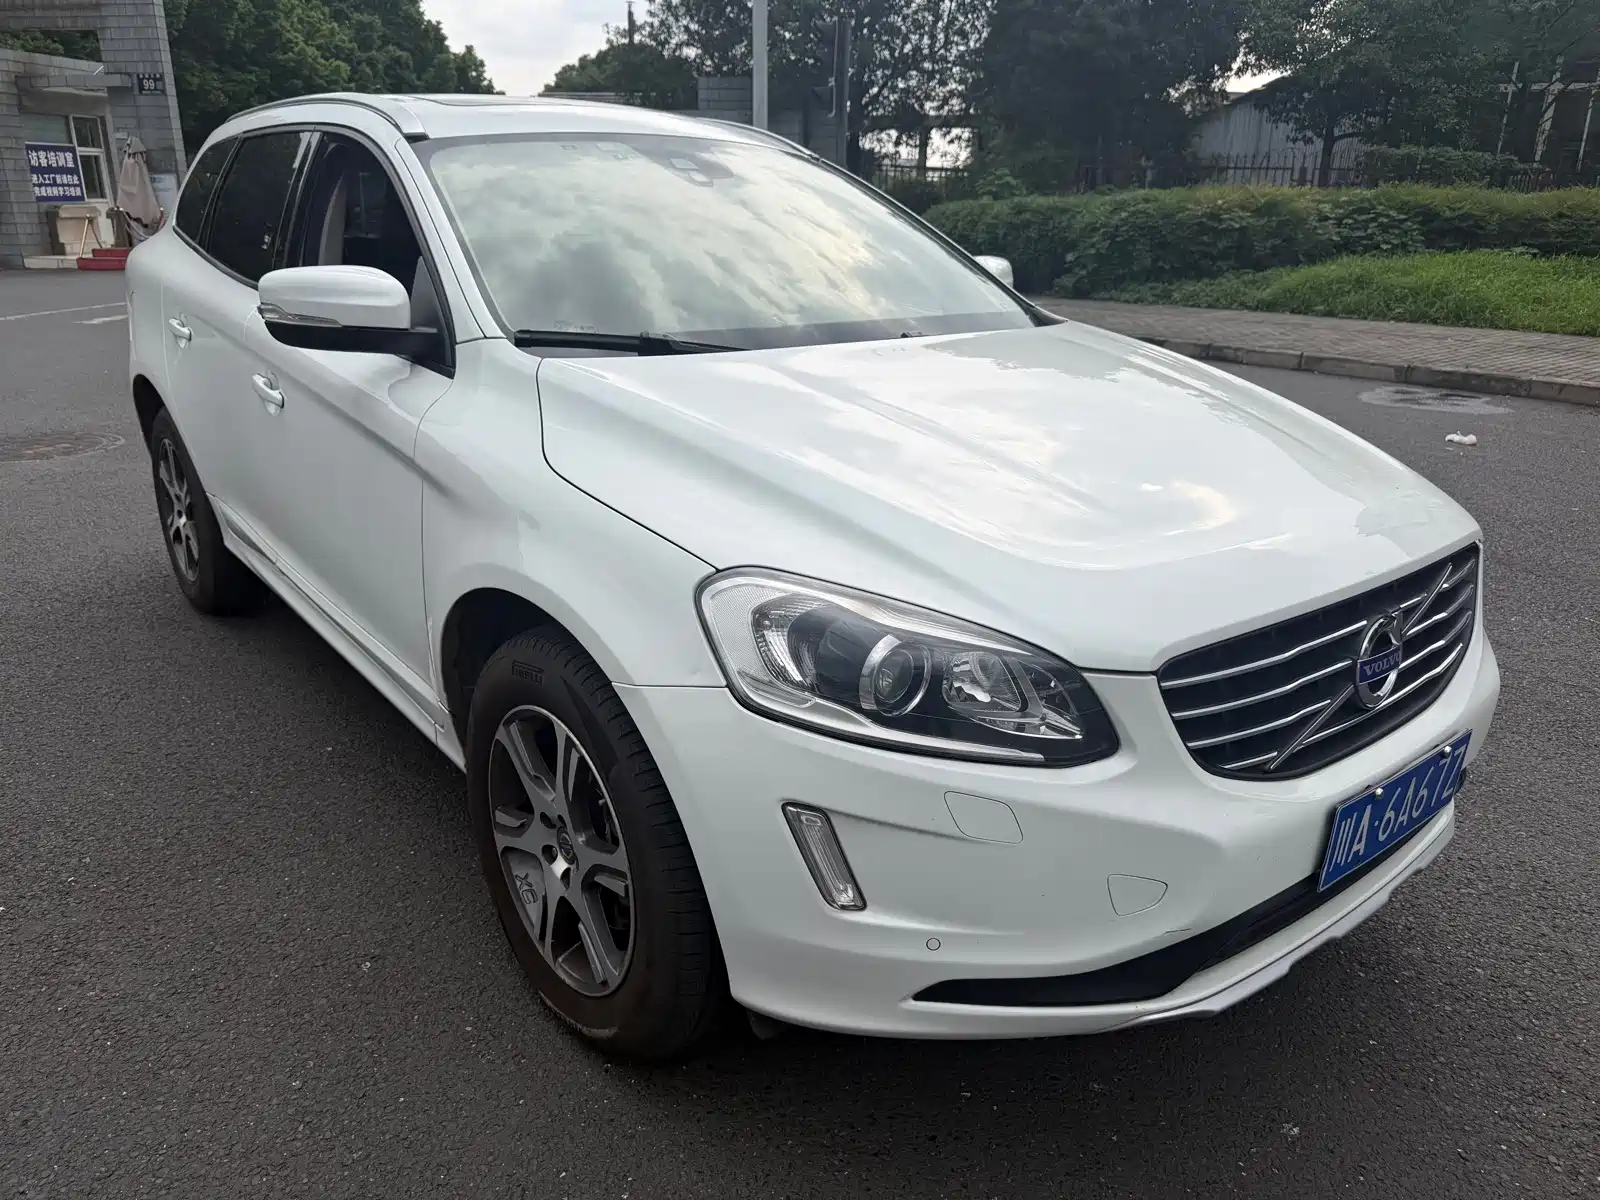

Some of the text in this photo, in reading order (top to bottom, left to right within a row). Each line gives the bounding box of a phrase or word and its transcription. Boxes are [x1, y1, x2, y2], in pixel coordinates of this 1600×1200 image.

[143, 79, 155, 90] 99
[28, 150, 75, 168] 访客培训室
[31, 173, 80, 185] 进入工厂前请在此
[1363, 650, 1402, 677] VOLVO
[514, 871, 539, 905] XC
